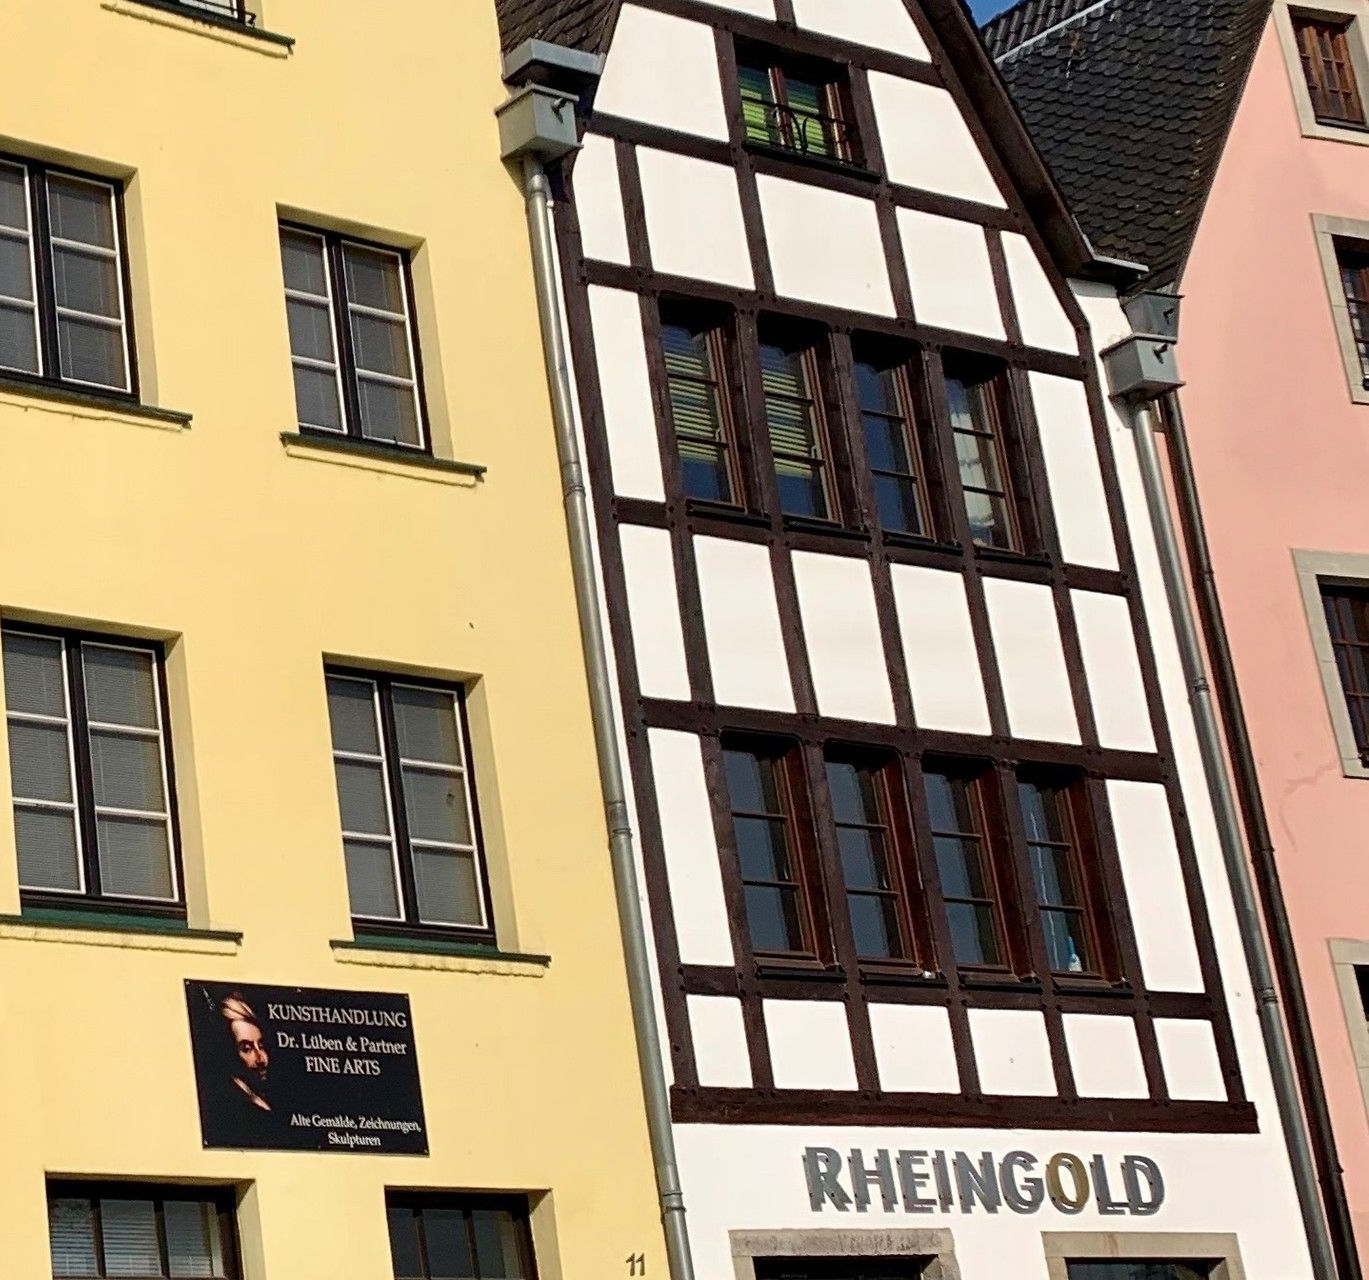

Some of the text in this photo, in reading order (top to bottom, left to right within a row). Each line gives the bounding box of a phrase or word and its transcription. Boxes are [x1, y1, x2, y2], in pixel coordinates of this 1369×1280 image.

[266, 1002, 408, 1029] KUNSTHANDLUNG
[276, 1031, 408, 1056] Dr. Lüben & Partner
[304, 1055, 381, 1076] FINE ARTS
[289, 1112, 422, 1135] Alte Gemälde, Zeichnungen,
[327, 1131, 382, 1149] Skulpturen
[801, 1145, 1166, 1216] RHEINGOLD
[625, 1252, 646, 1277] 11
